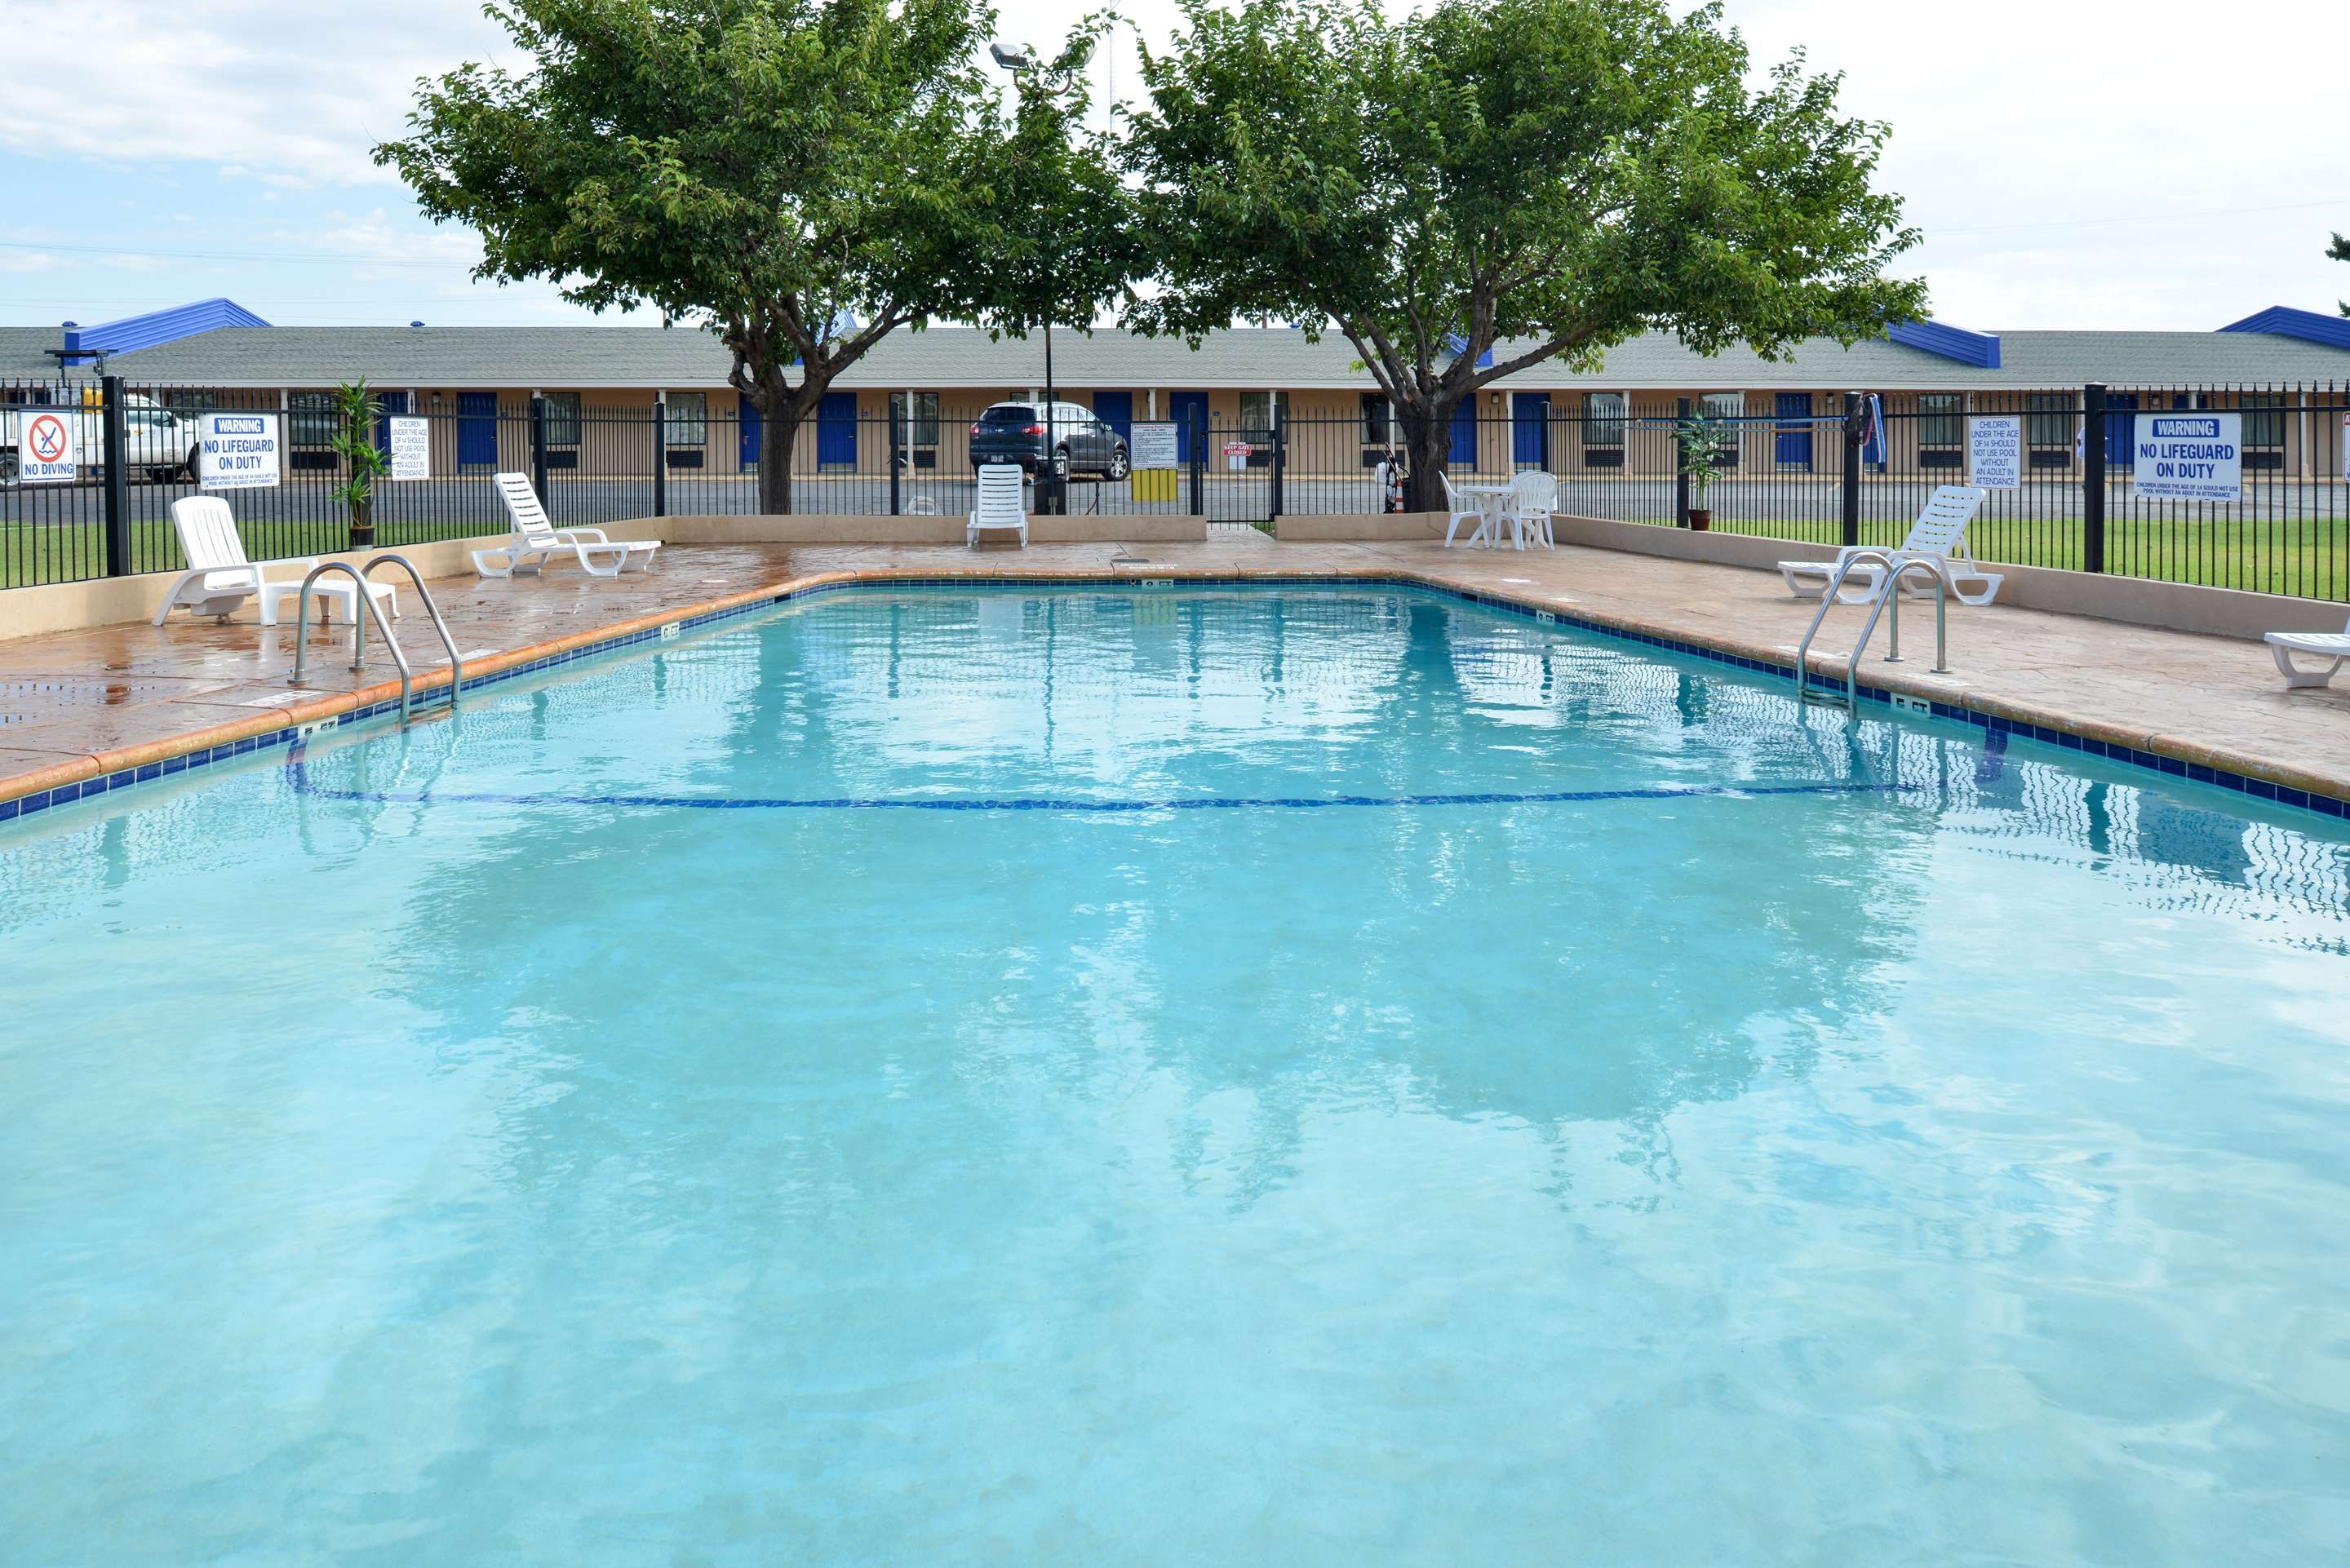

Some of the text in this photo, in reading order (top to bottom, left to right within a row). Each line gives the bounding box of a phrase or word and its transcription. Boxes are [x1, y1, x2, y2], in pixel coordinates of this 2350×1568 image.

[218, 419, 261, 432] WARNING
[2157, 421, 2214, 436] WARNING
[1971, 430, 1992, 438] UNDER
[204, 439, 274, 454] NO LIFEGUARD
[1973, 449, 2017, 457] NOT USE POOL
[2140, 443, 2234, 460] NO LIFEGUARD
[25, 463, 74, 475] NO DIVING
[219, 455, 262, 470] ON DUTY
[2157, 462, 2215, 479] ON DUTY
[1975, 477, 2015, 485] ATTENDANCE
